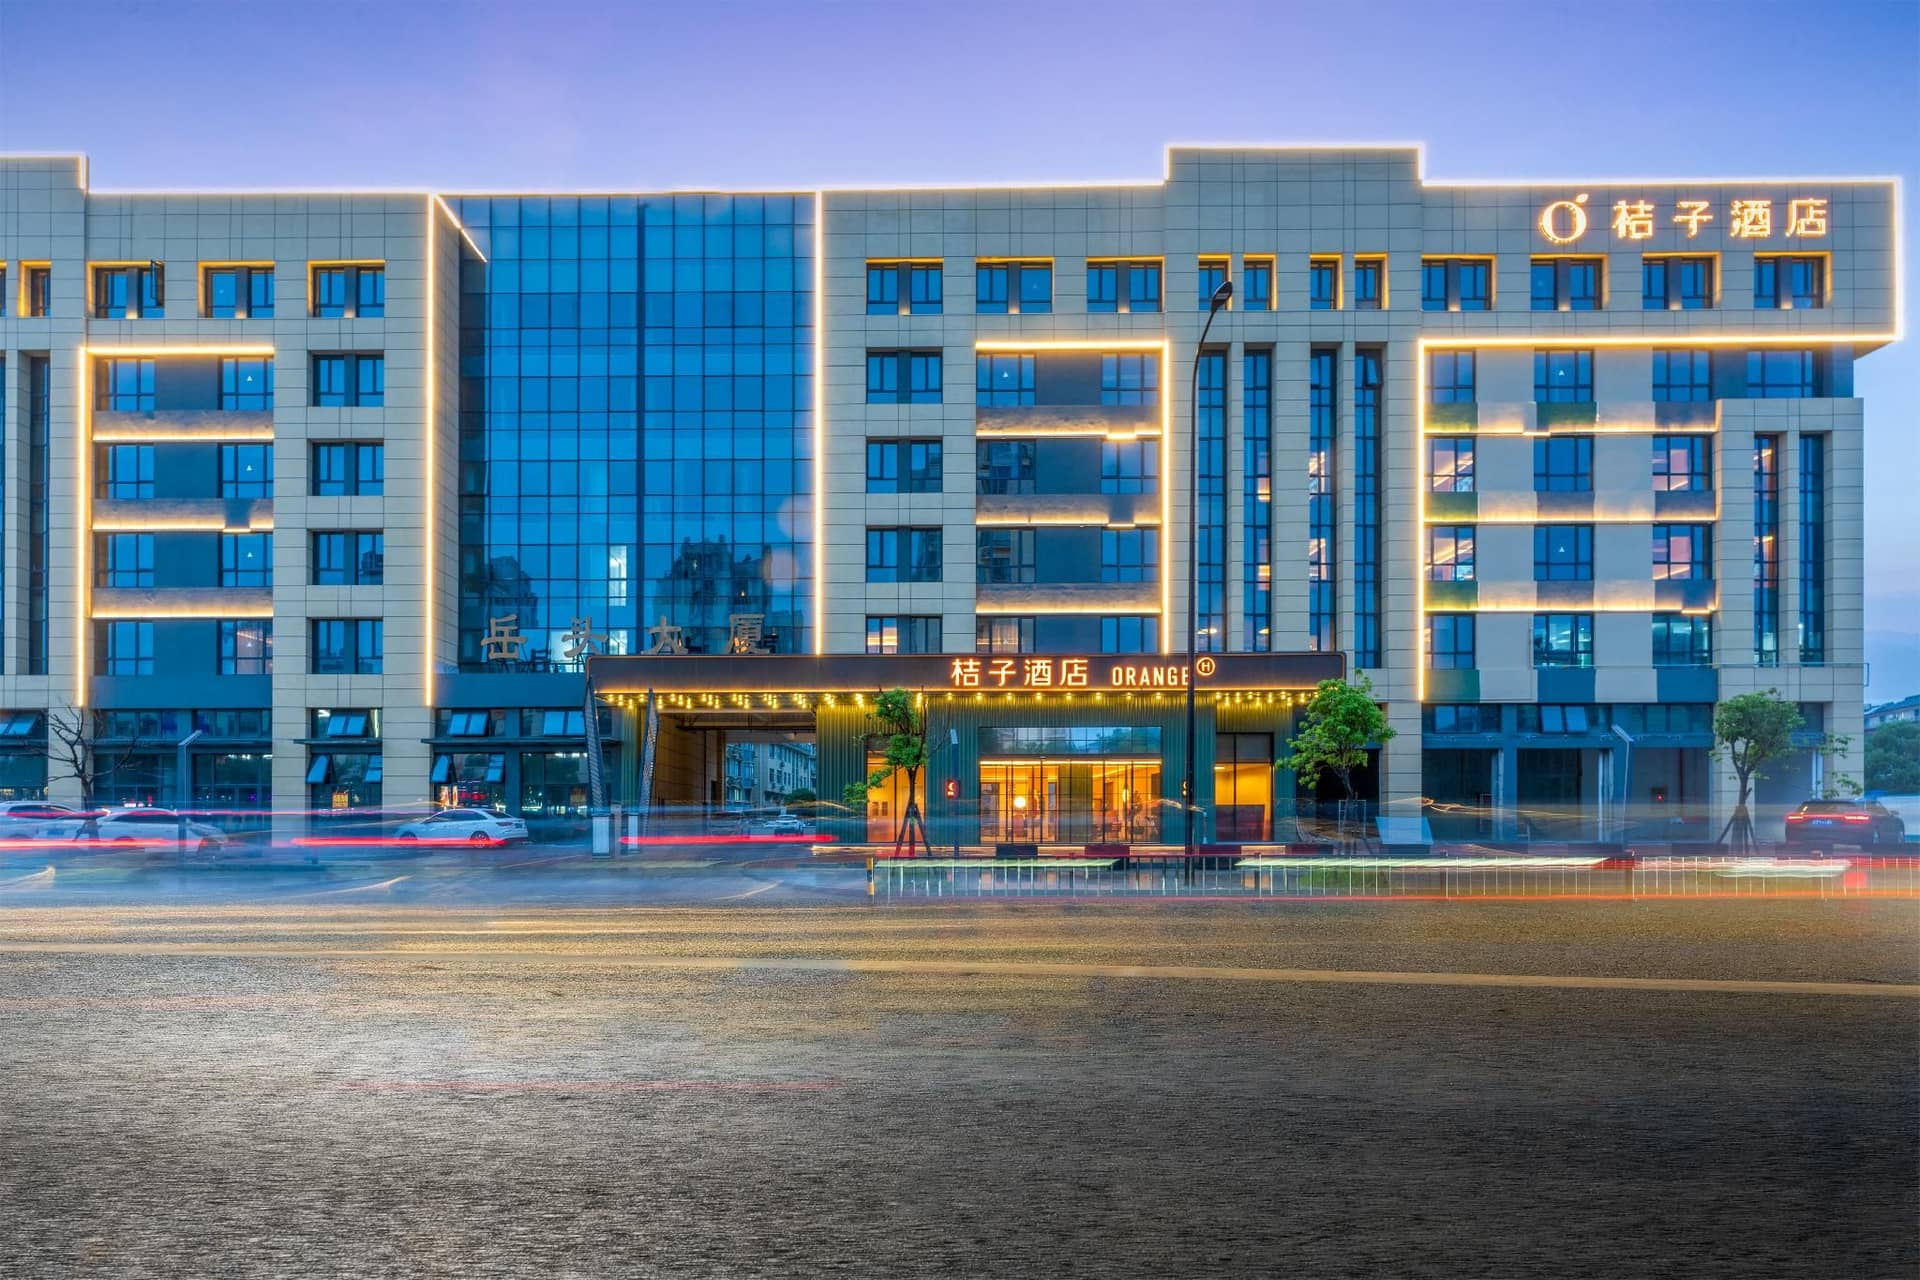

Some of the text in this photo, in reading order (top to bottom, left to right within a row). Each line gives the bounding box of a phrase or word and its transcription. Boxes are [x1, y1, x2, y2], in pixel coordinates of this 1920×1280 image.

[1612, 198, 1828, 239] 桔子酒店
[951, 658, 1089, 687] 桔子酒店
[1112, 666, 1189, 686] ORANGE
